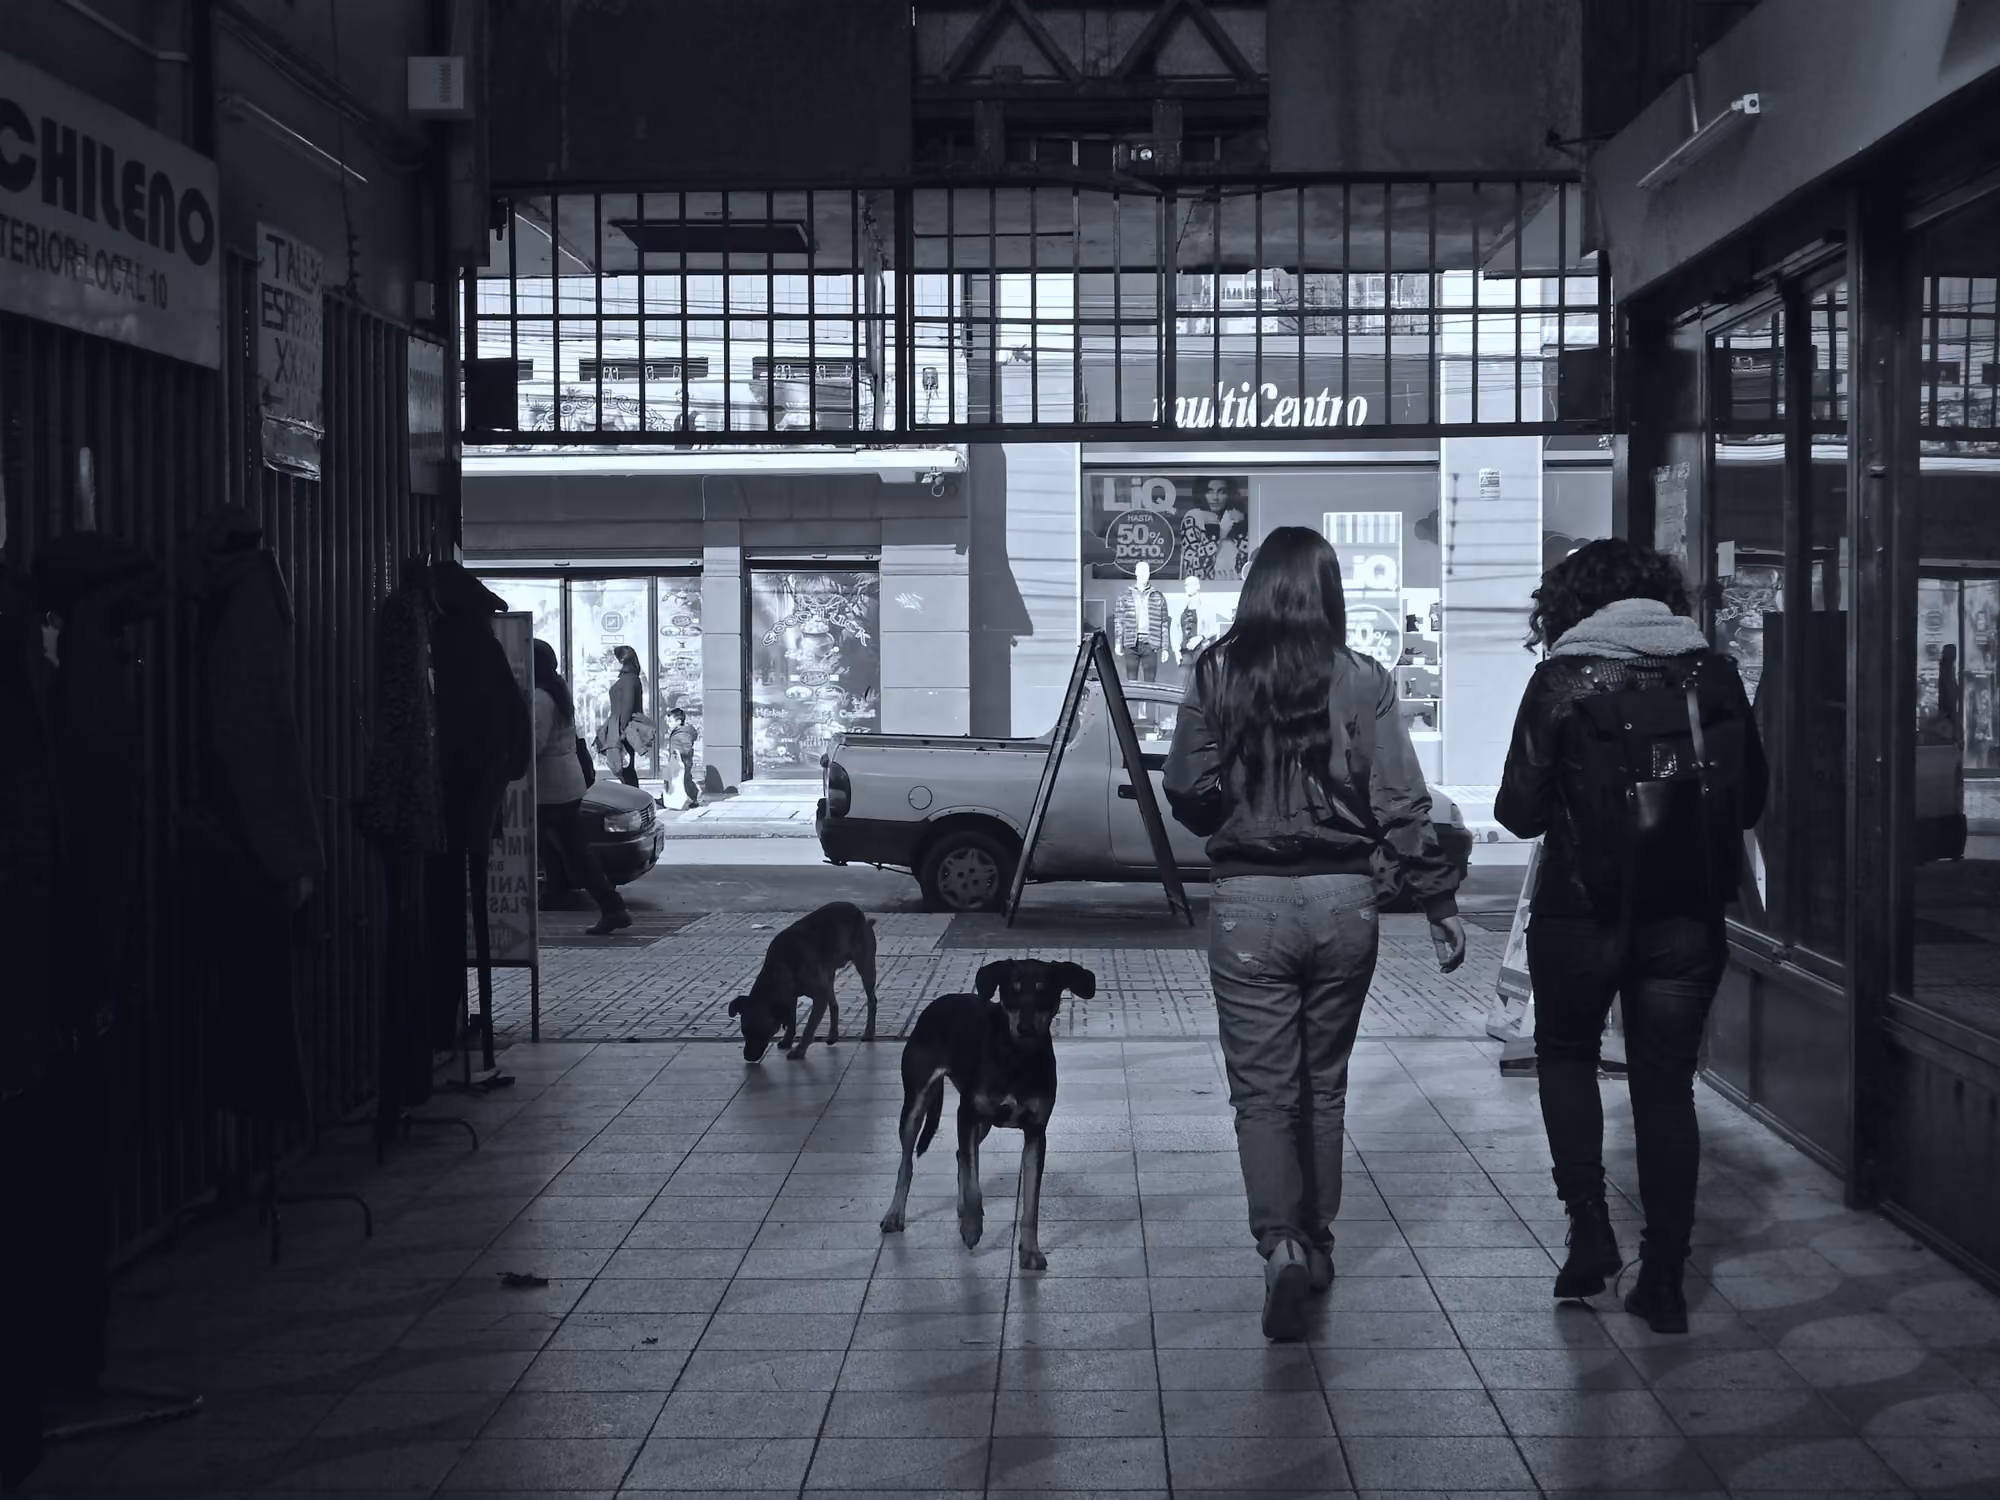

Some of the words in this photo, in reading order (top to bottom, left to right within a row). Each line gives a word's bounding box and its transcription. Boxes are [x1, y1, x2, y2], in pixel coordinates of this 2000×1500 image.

[0, 98, 214, 266] CHILENO
[82, 243, 146, 302] LOCAL
[150, 268, 168, 310] 10
[1127, 514, 1154, 522] HASTA
[1116, 523, 1165, 545] 50%
[1116, 544, 1165, 558] DCTO.
